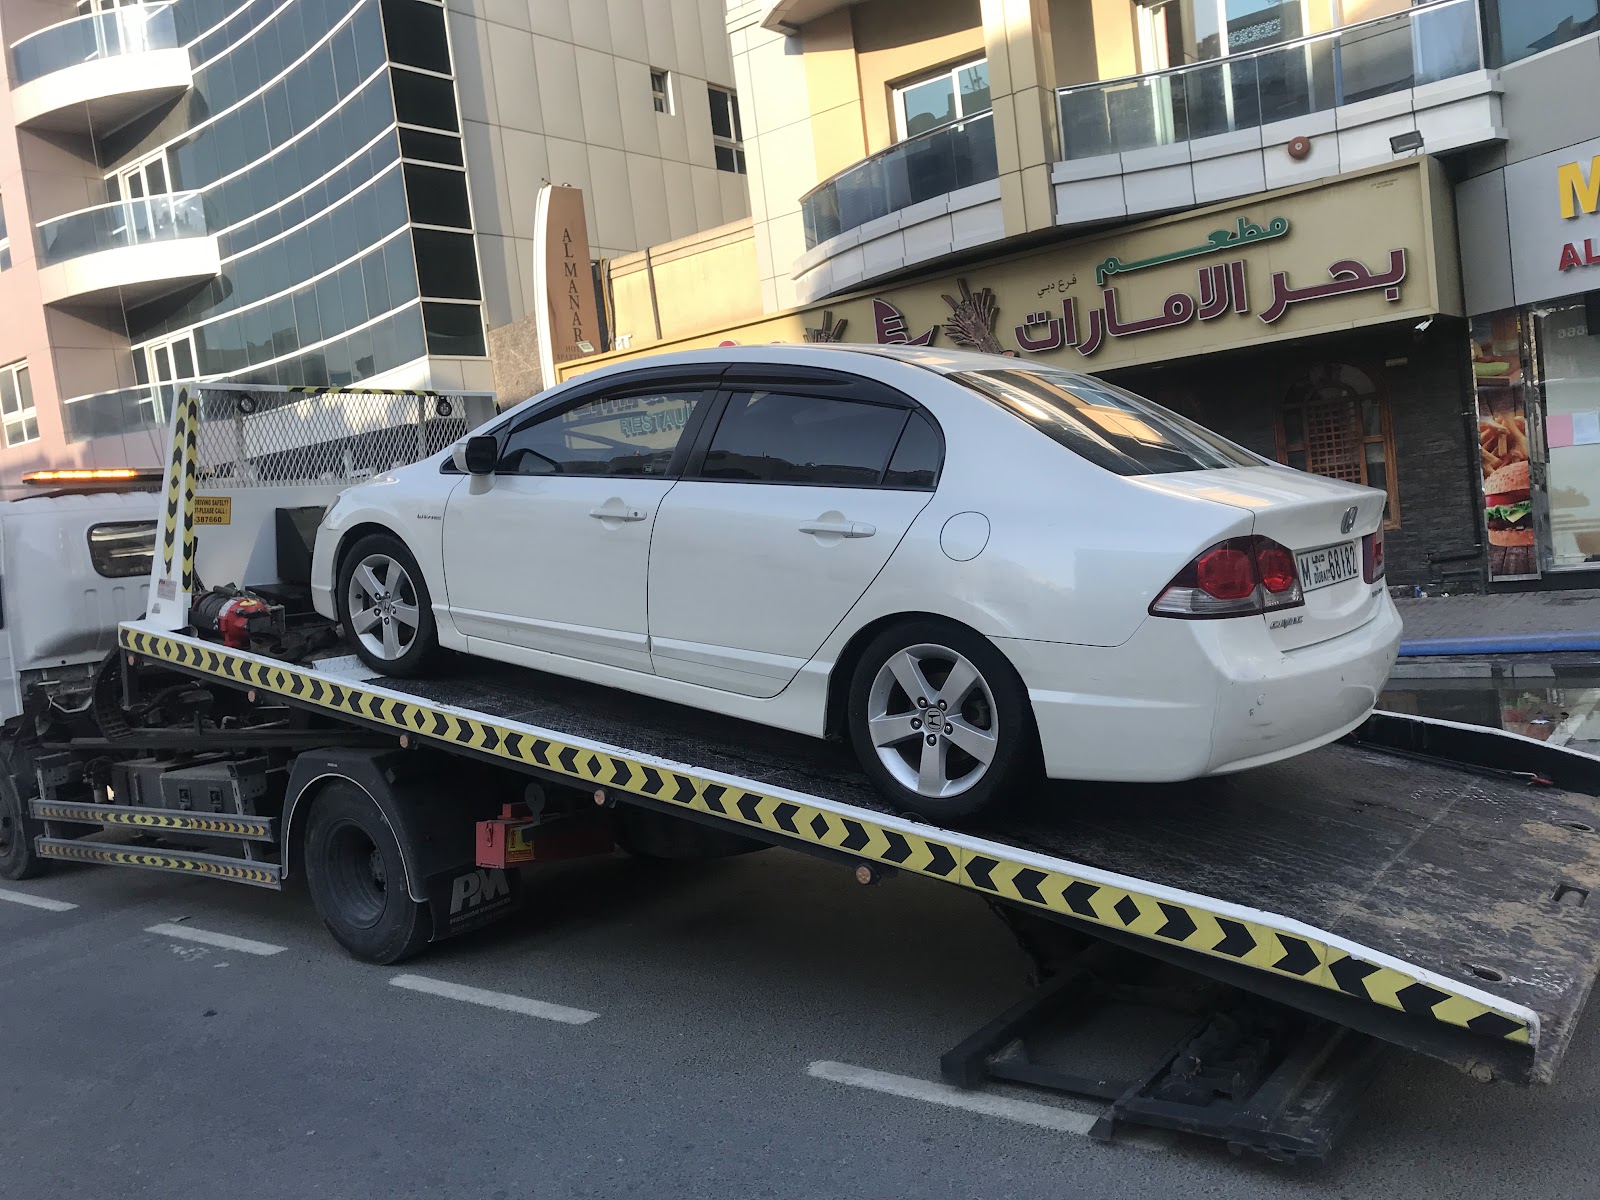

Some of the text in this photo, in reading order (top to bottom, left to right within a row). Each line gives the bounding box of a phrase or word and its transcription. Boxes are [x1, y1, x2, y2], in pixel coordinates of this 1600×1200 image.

[1096, 216, 1288, 286] مطعم
[1014, 248, 1407, 356] بحر الامارات
[1037, 273, 1077, 299] فرع دبي
[1301, 545, 1357, 587] M 68182
[450, 869, 510, 914] PM
